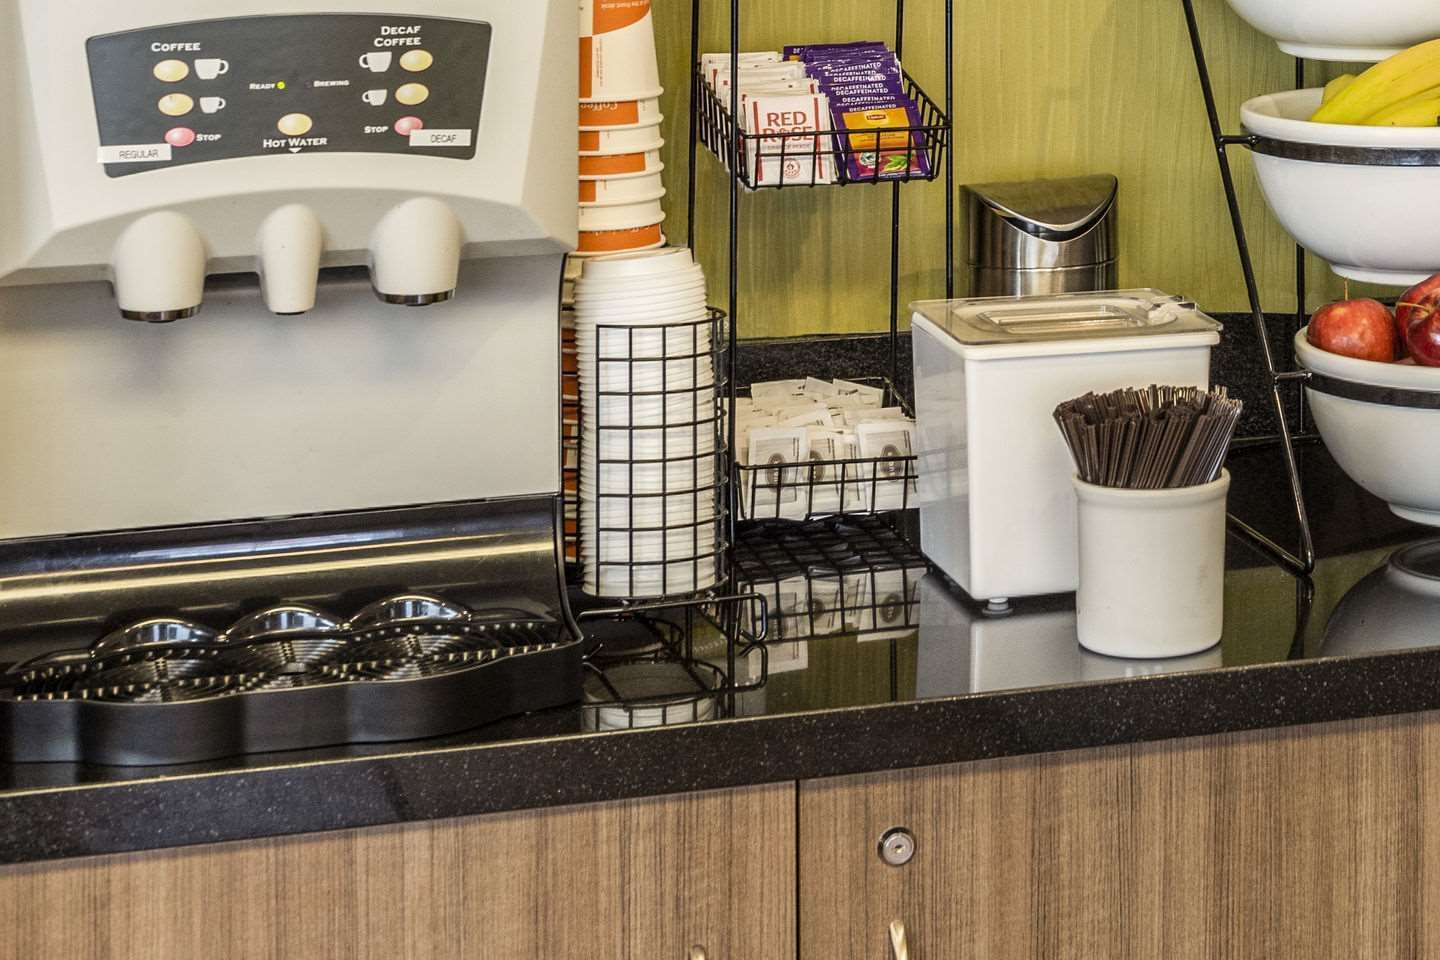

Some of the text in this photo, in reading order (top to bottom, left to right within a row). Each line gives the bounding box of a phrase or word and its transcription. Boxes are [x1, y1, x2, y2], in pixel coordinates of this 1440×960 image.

[381, 26, 421, 35] DECAF
[767, 112, 807, 127] RED
[364, 126, 389, 134] STOP
[196, 134, 221, 142] STOP
[263, 137, 328, 148] HOT WATER
[430, 134, 457, 143] DECAF
[119, 149, 159, 159] REGULAR
